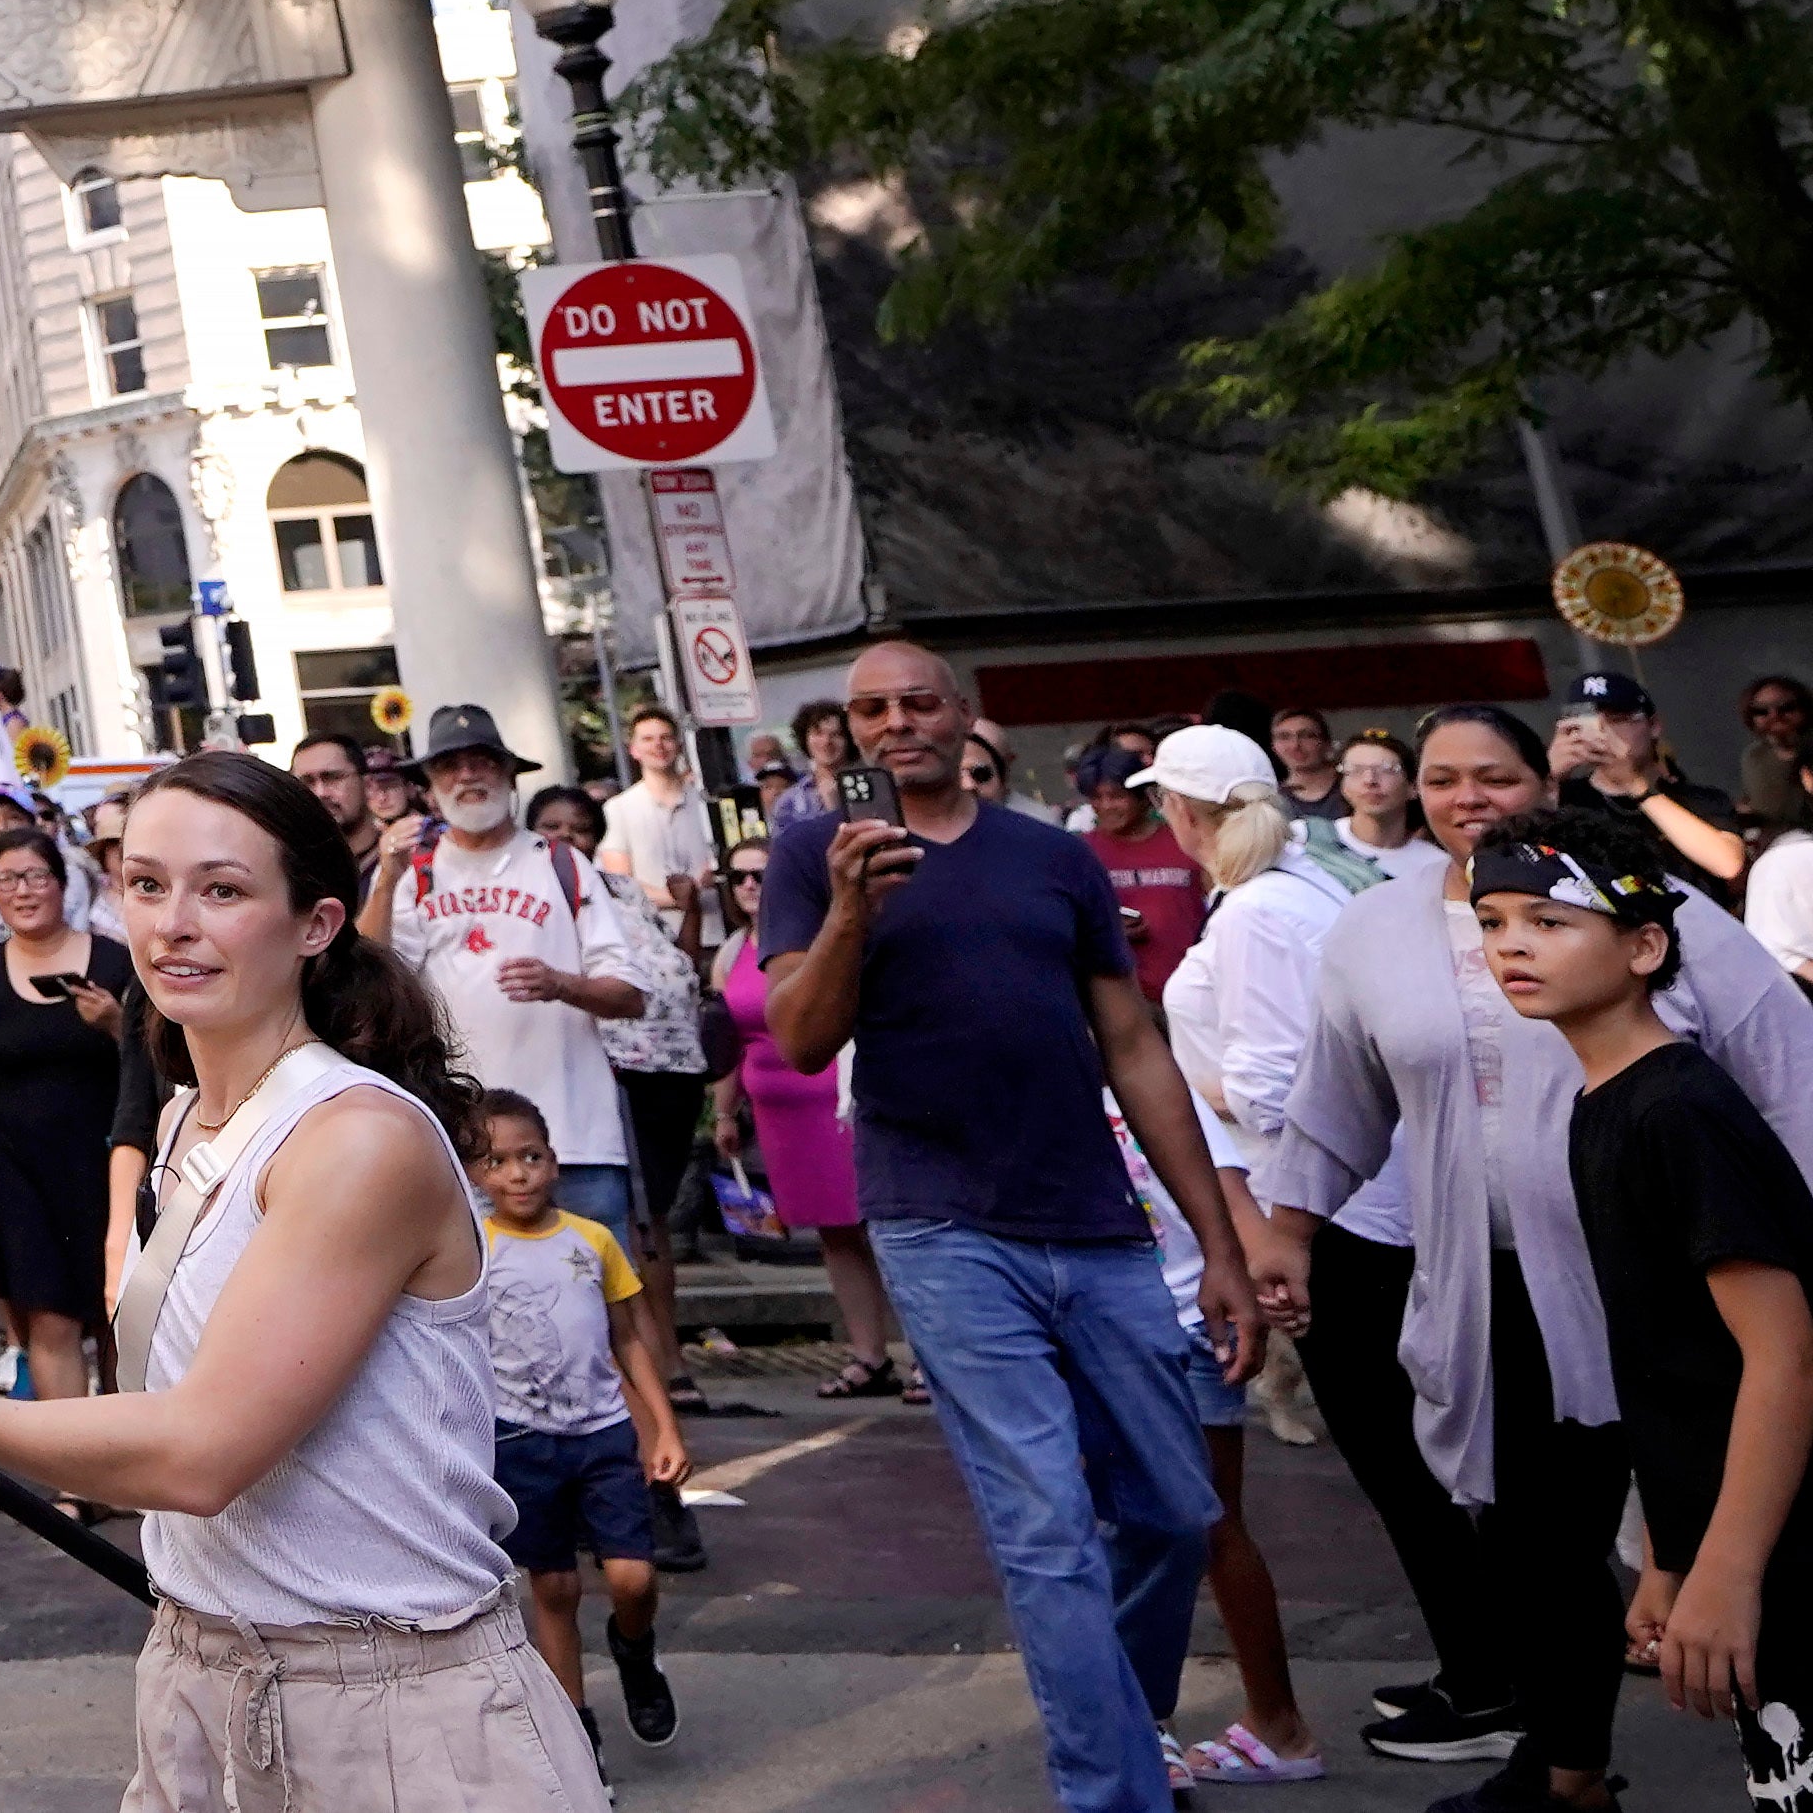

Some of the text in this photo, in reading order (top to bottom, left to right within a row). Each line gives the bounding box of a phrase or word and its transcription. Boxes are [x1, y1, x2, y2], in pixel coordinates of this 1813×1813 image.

[564, 297, 709, 338] DO NOT
[593, 389, 718, 427] ENTER
